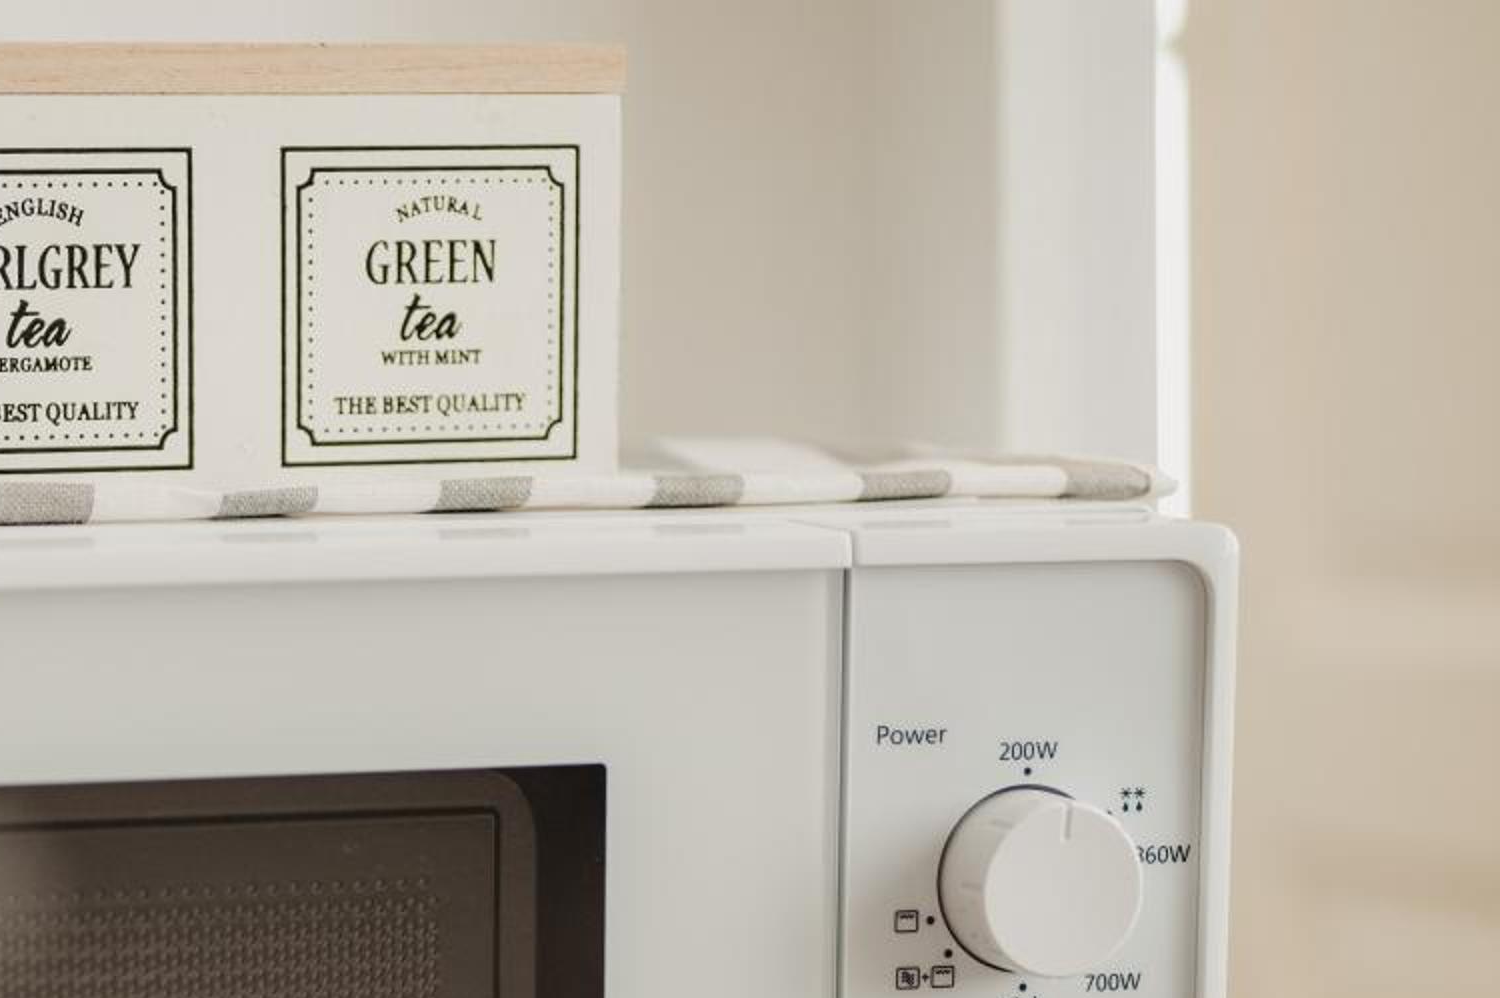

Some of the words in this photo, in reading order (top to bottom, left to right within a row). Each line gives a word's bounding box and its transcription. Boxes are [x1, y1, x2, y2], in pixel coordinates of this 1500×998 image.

[395, 195, 482, 223] NATURAL
[365, 239, 496, 285] GREEN
[5, 299, 72, 349] tea
[399, 293, 462, 342] tea
[381, 349, 430, 366] WITH
[435, 348, 482, 365] MINT
[45, 401, 139, 427] QUALITY
[334, 396, 377, 415] THE
[383, 395, 432, 415] BEST
[436, 392, 526, 417] QUALITY
[876, 725, 948, 745] Power
[998, 740, 1059, 761] 200W
[1085, 972, 1142, 993] 700W
